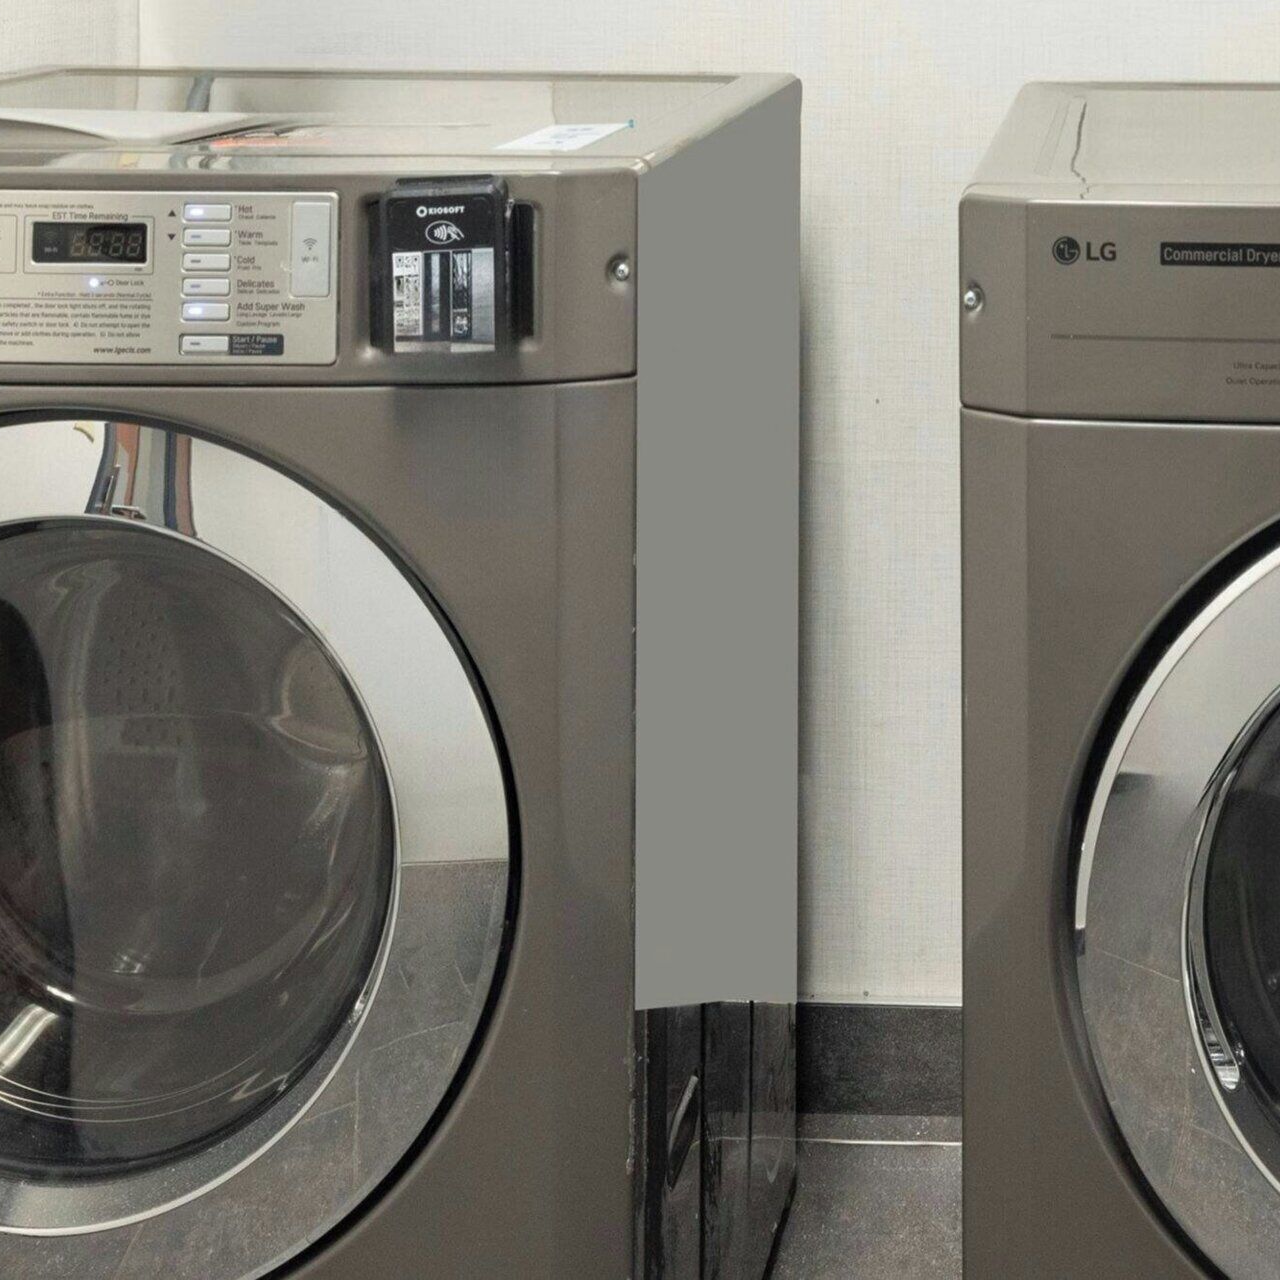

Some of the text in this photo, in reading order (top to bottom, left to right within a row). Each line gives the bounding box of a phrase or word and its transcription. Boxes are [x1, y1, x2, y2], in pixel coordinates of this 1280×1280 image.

[428, 206, 465, 215] KIOSOFT
[89, 213, 128, 221] Remaining
[1086, 242, 1117, 261] LG
[1164, 247, 1243, 262] Commercial
[236, 280, 275, 288] Delicates
[237, 303, 305, 312] Add Super Wash
[256, 336, 278, 344] Pause
[1232, 361, 1253, 369] Ultra
